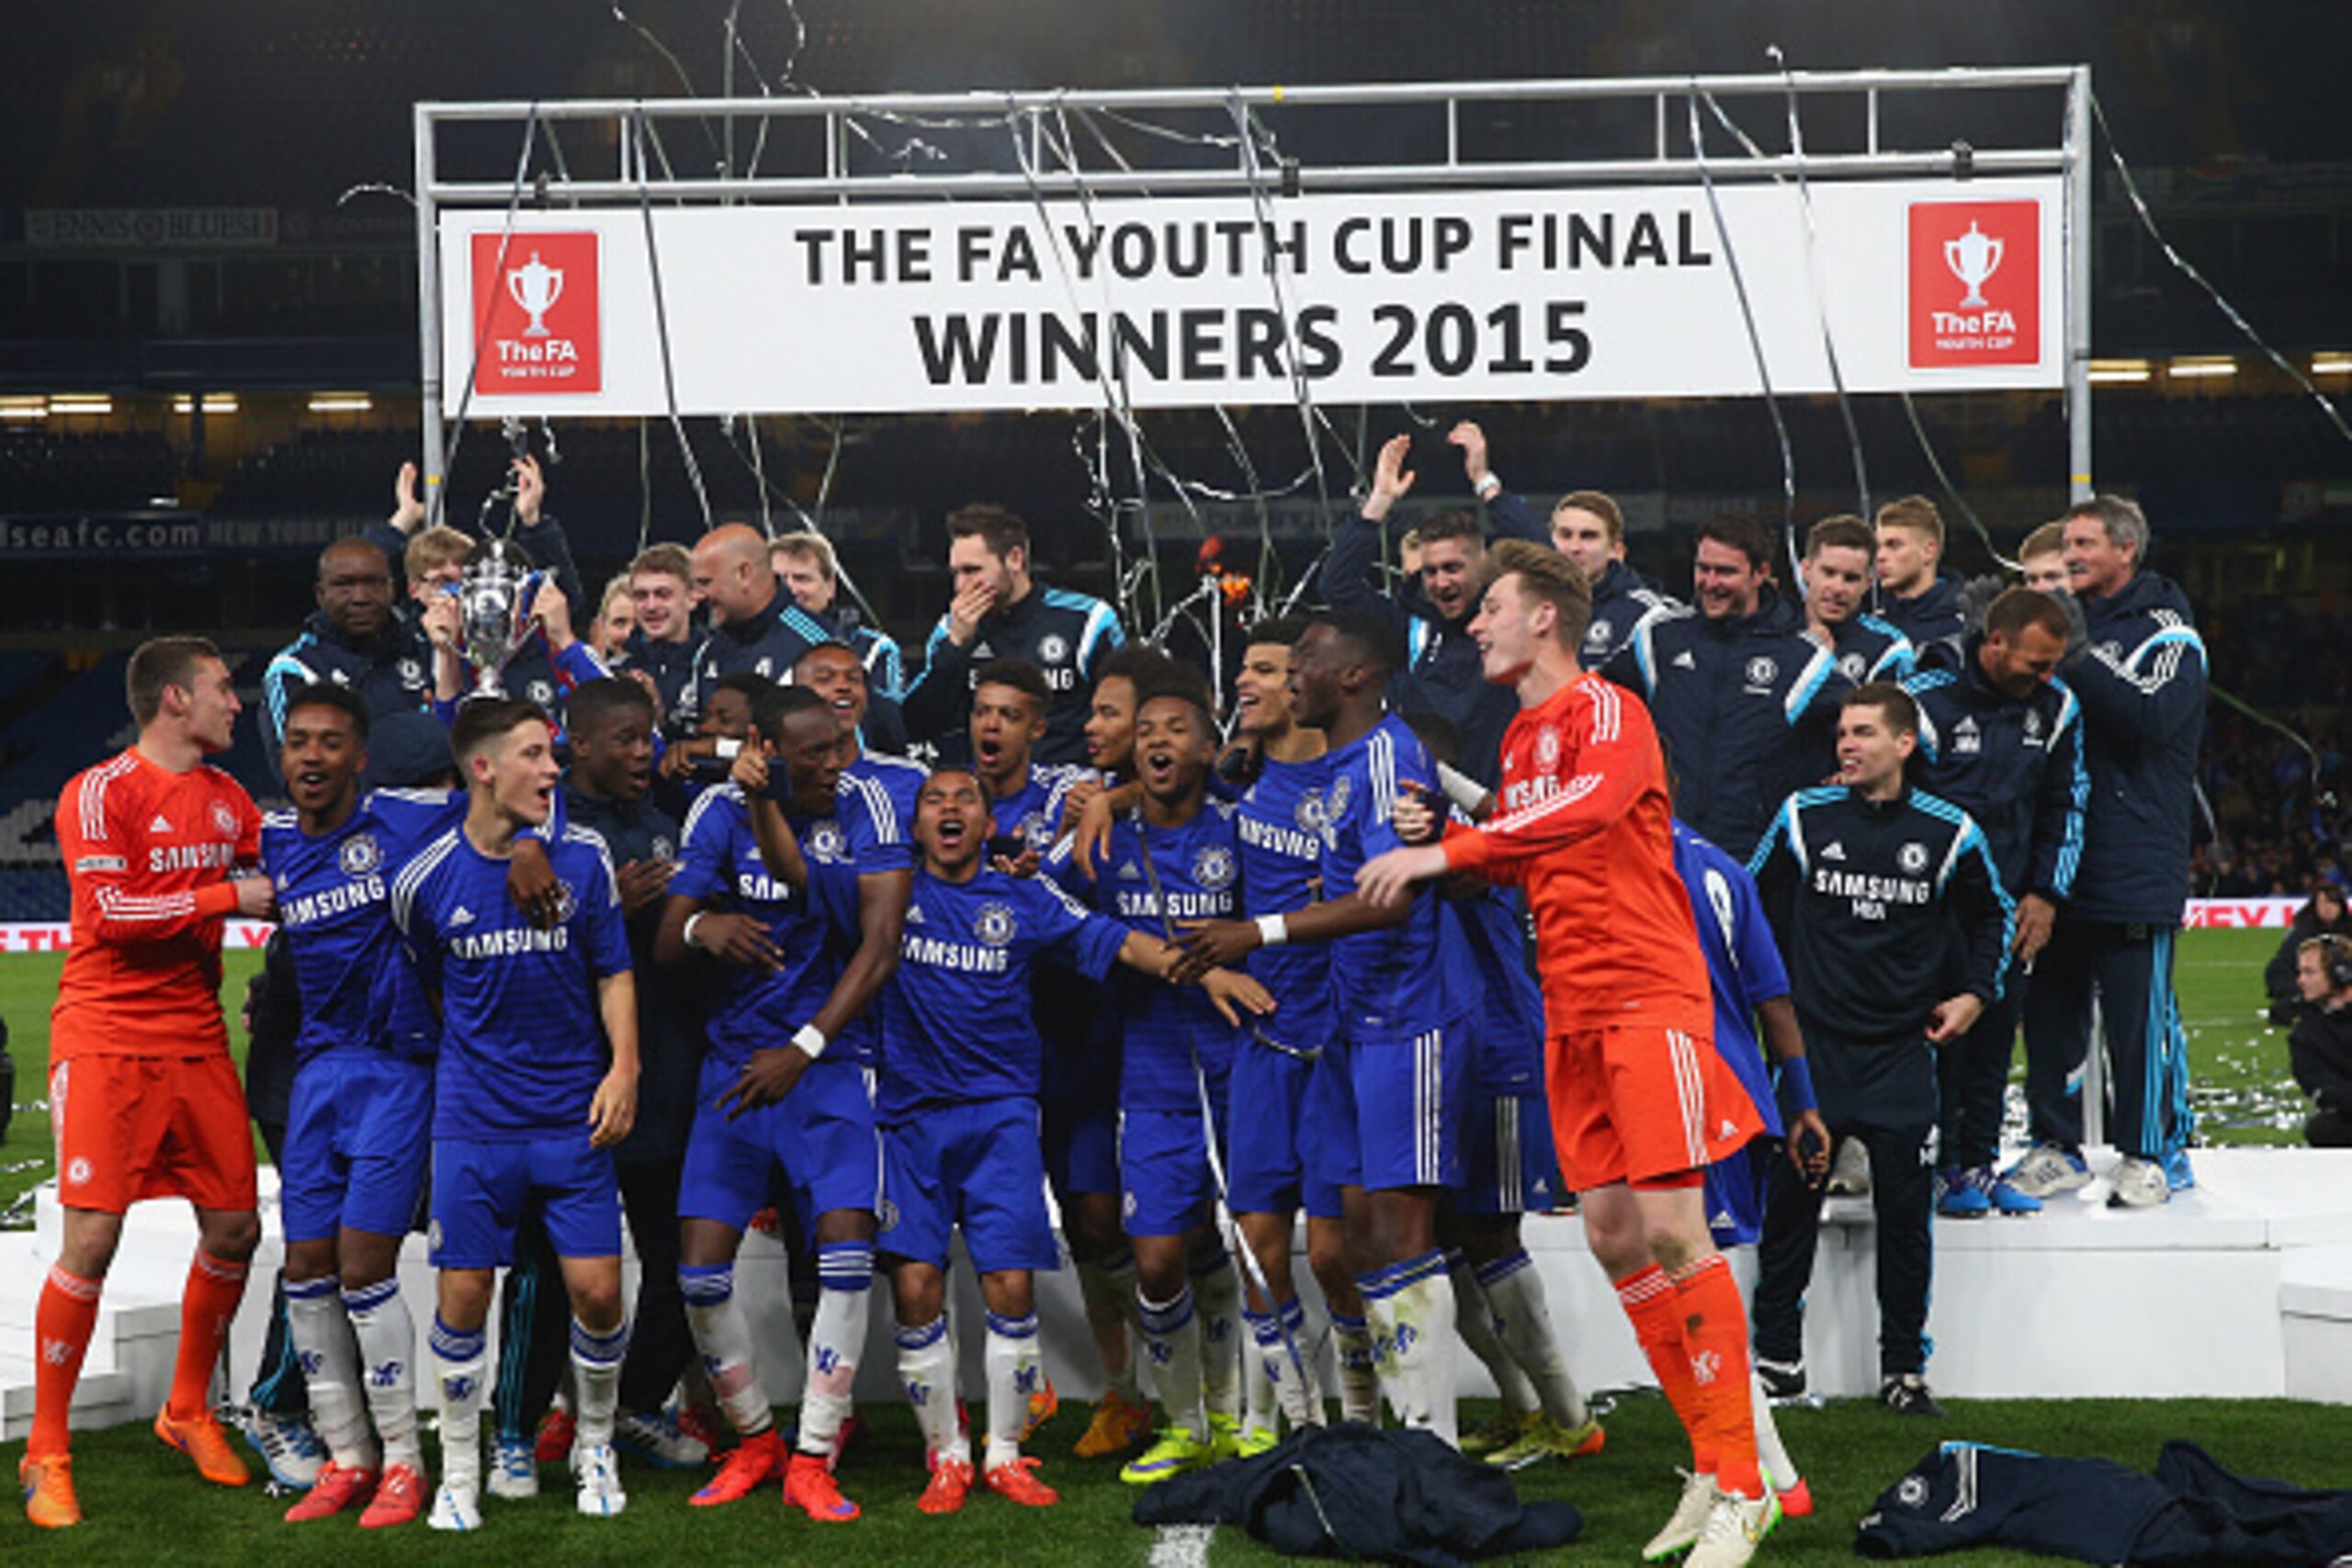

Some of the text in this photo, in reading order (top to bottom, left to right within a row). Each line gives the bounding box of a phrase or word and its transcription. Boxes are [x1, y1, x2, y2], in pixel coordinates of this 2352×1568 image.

[795, 210, 1712, 284] THE FA YOUTH CUP FINAL
[911, 300, 1592, 385] WINNERS 2015
[1814, 868, 1929, 904] SAMSUNG
